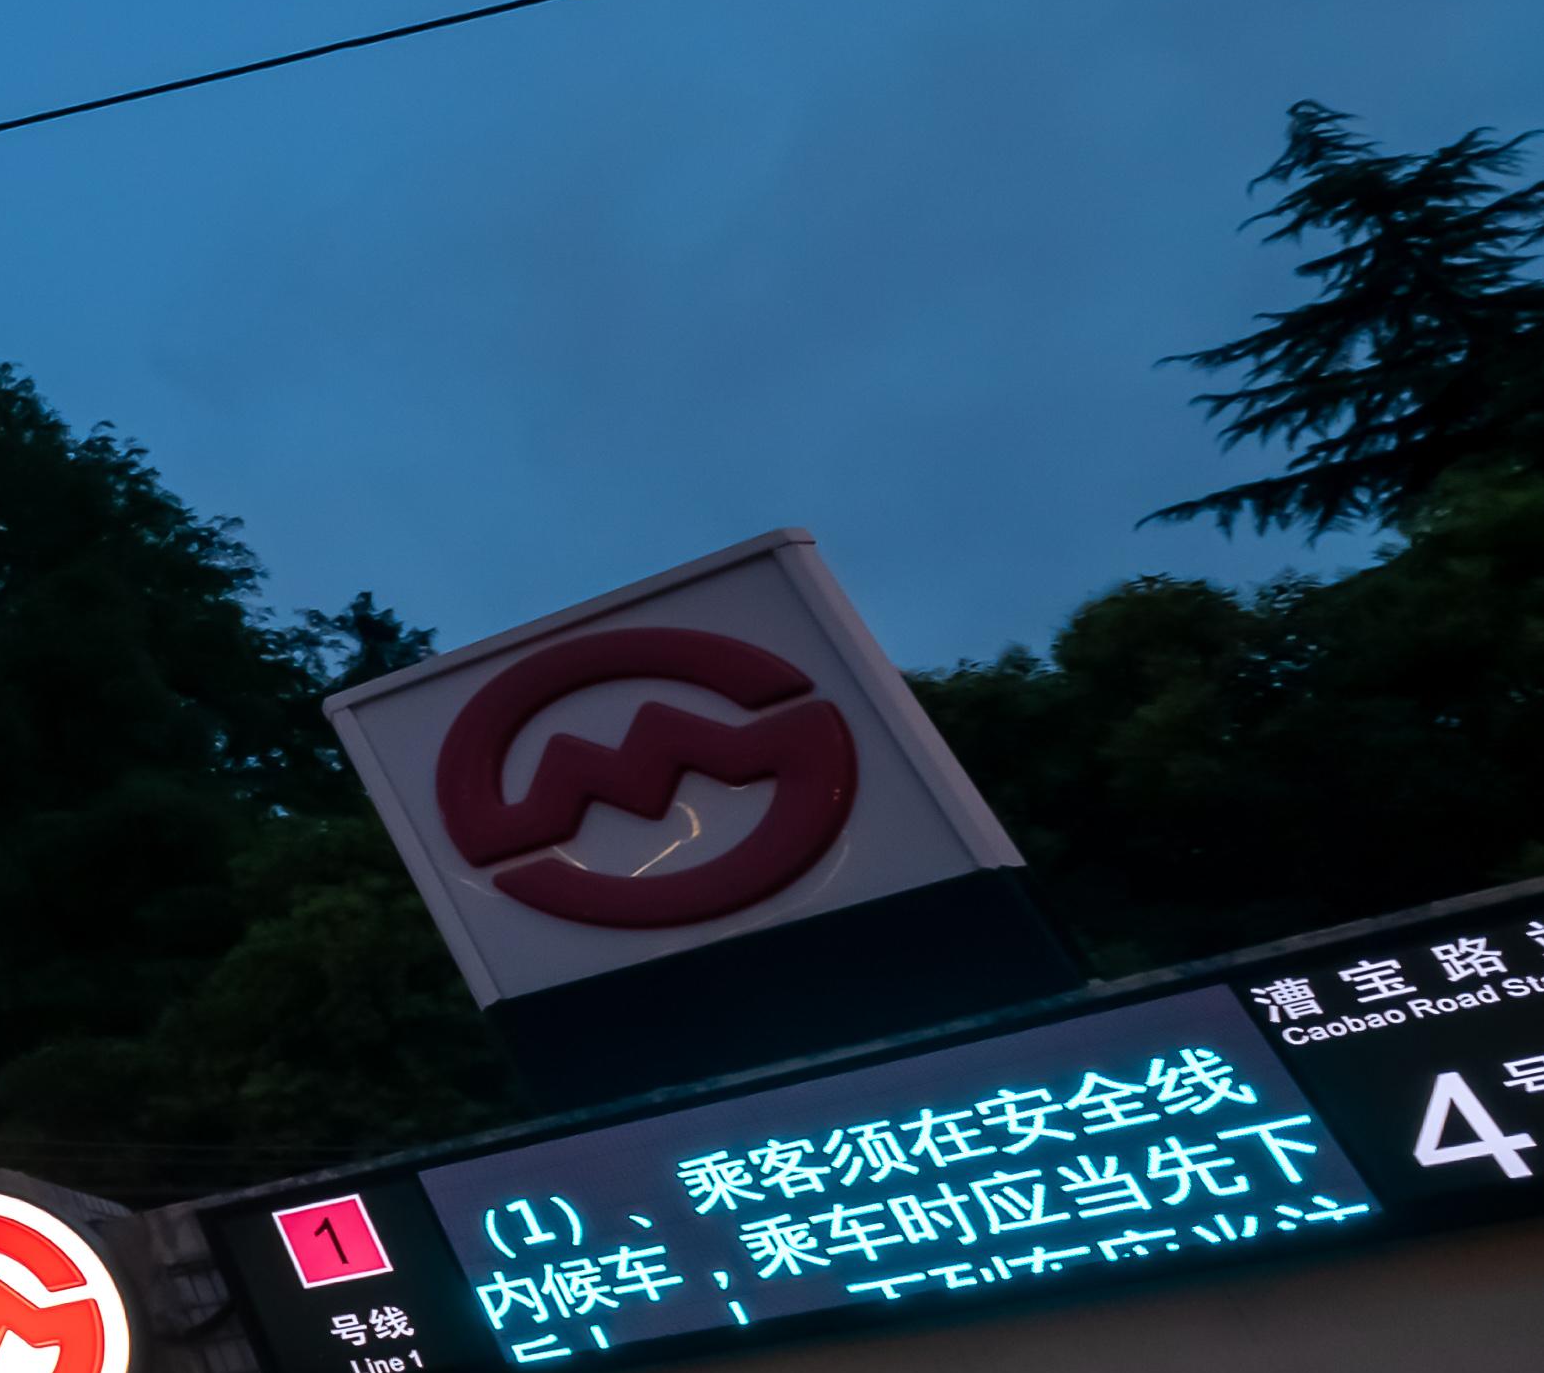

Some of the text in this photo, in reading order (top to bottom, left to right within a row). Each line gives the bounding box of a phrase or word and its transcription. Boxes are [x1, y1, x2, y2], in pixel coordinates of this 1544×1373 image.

[1281, 975, 1544, 1045] Caobao Road St
[314, 1217, 349, 1265] 1
[330, 1306, 415, 1346] 号线
[408, 1349, 424, 1368] 1
